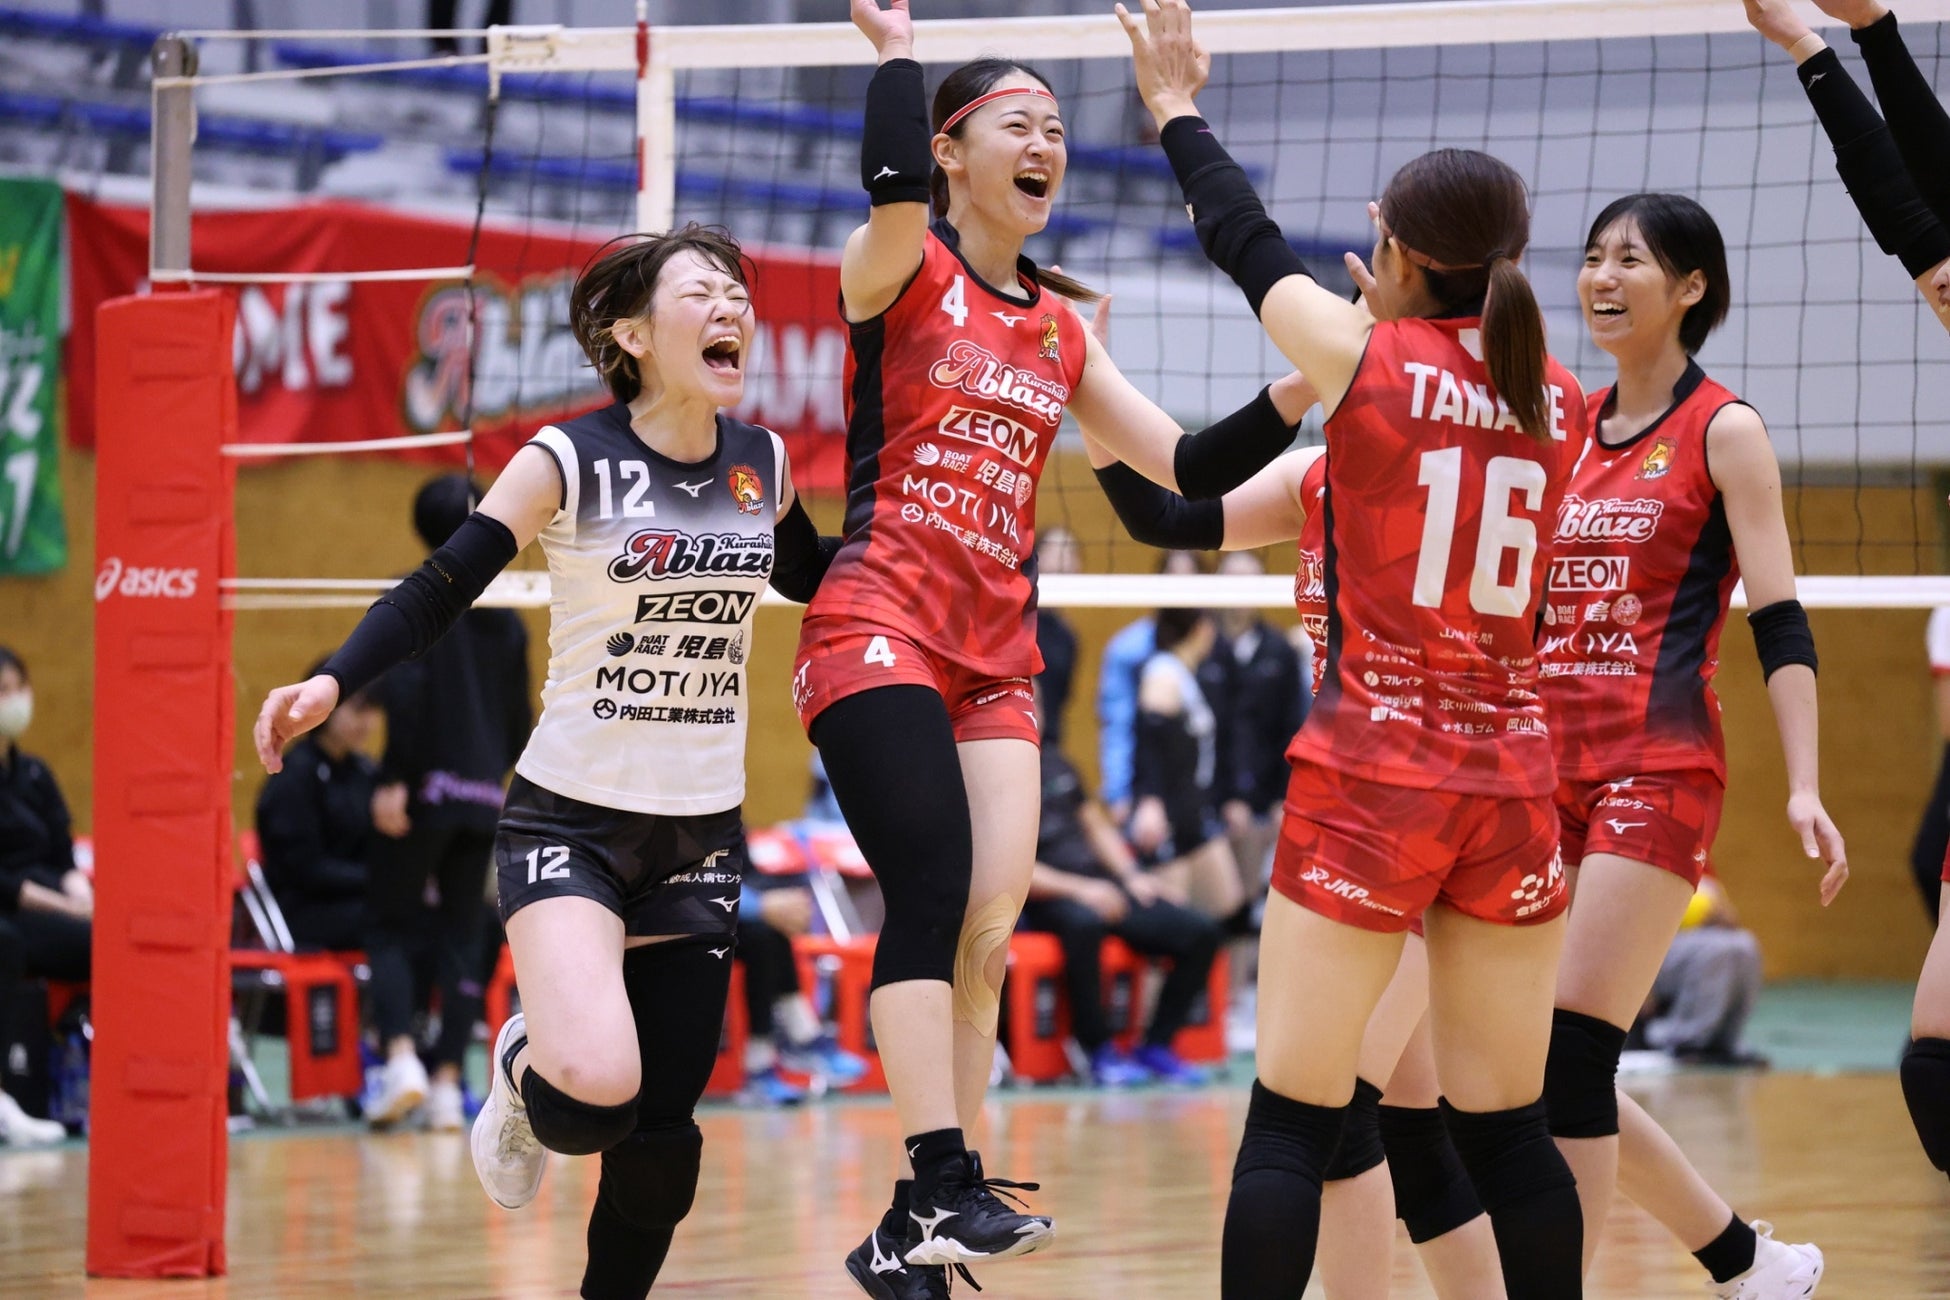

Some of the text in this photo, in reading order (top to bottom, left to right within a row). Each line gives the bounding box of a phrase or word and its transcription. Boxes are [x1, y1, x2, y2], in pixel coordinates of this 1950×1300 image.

[941, 274, 968, 326] 4
[930, 341, 1064, 426] Ablaze
[1404, 362, 1567, 440] TANAE
[942, 408, 1037, 464] ZEON
[940, 458, 969, 474] RACE
[944, 449, 973, 464] BOAT
[593, 458, 656, 519] 12
[973, 459, 1016, 495] 児島
[1553, 494, 1655, 543] blaze
[1602, 500, 1659, 515] Kurashiki
[1412, 446, 1547, 618] 16
[609, 531, 773, 582] Ablaze
[1551, 557, 1626, 589] ZEON
[640, 591, 752, 622] ZEON
[633, 644, 667, 656] RACE
[640, 634, 671, 646] BOAT
[672, 635, 730, 661] 児島
[863, 635, 896, 668] 4
[619, 704, 736, 725] 内田工業株式会社
[526, 845, 571, 885] 12
[1323, 877, 1370, 900] JKP
